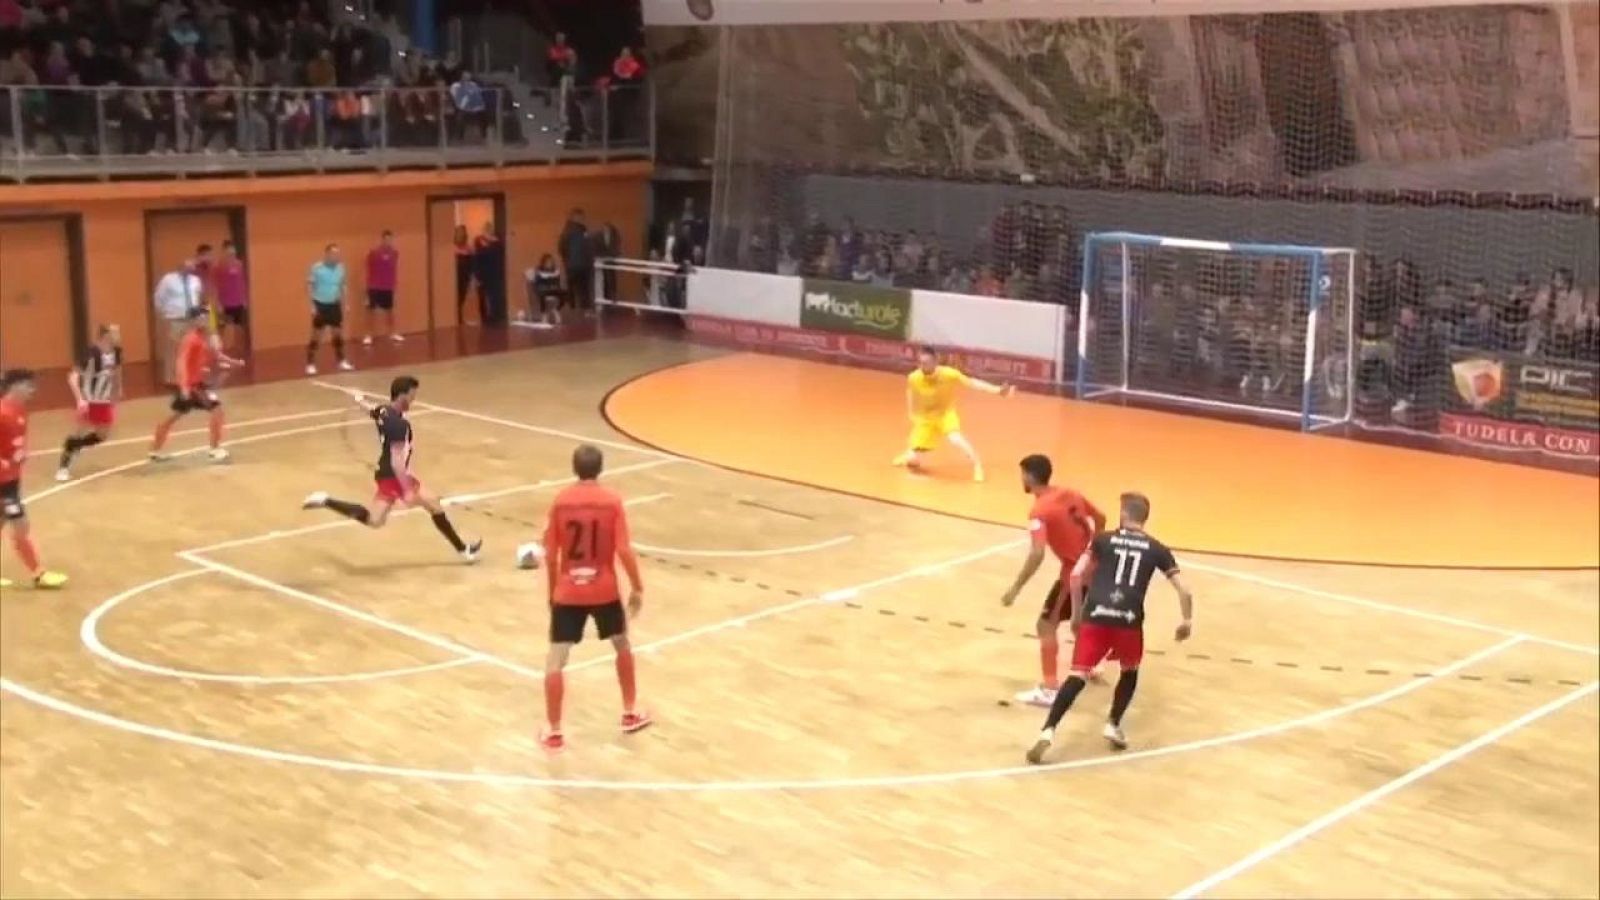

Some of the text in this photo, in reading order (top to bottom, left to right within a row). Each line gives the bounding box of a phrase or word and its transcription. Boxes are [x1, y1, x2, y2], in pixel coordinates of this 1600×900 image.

[1451, 421, 1536, 447] TUDELA
[1544, 433, 1591, 453] CON
[565, 519, 598, 560] 21
[1114, 548, 1141, 587] 77
